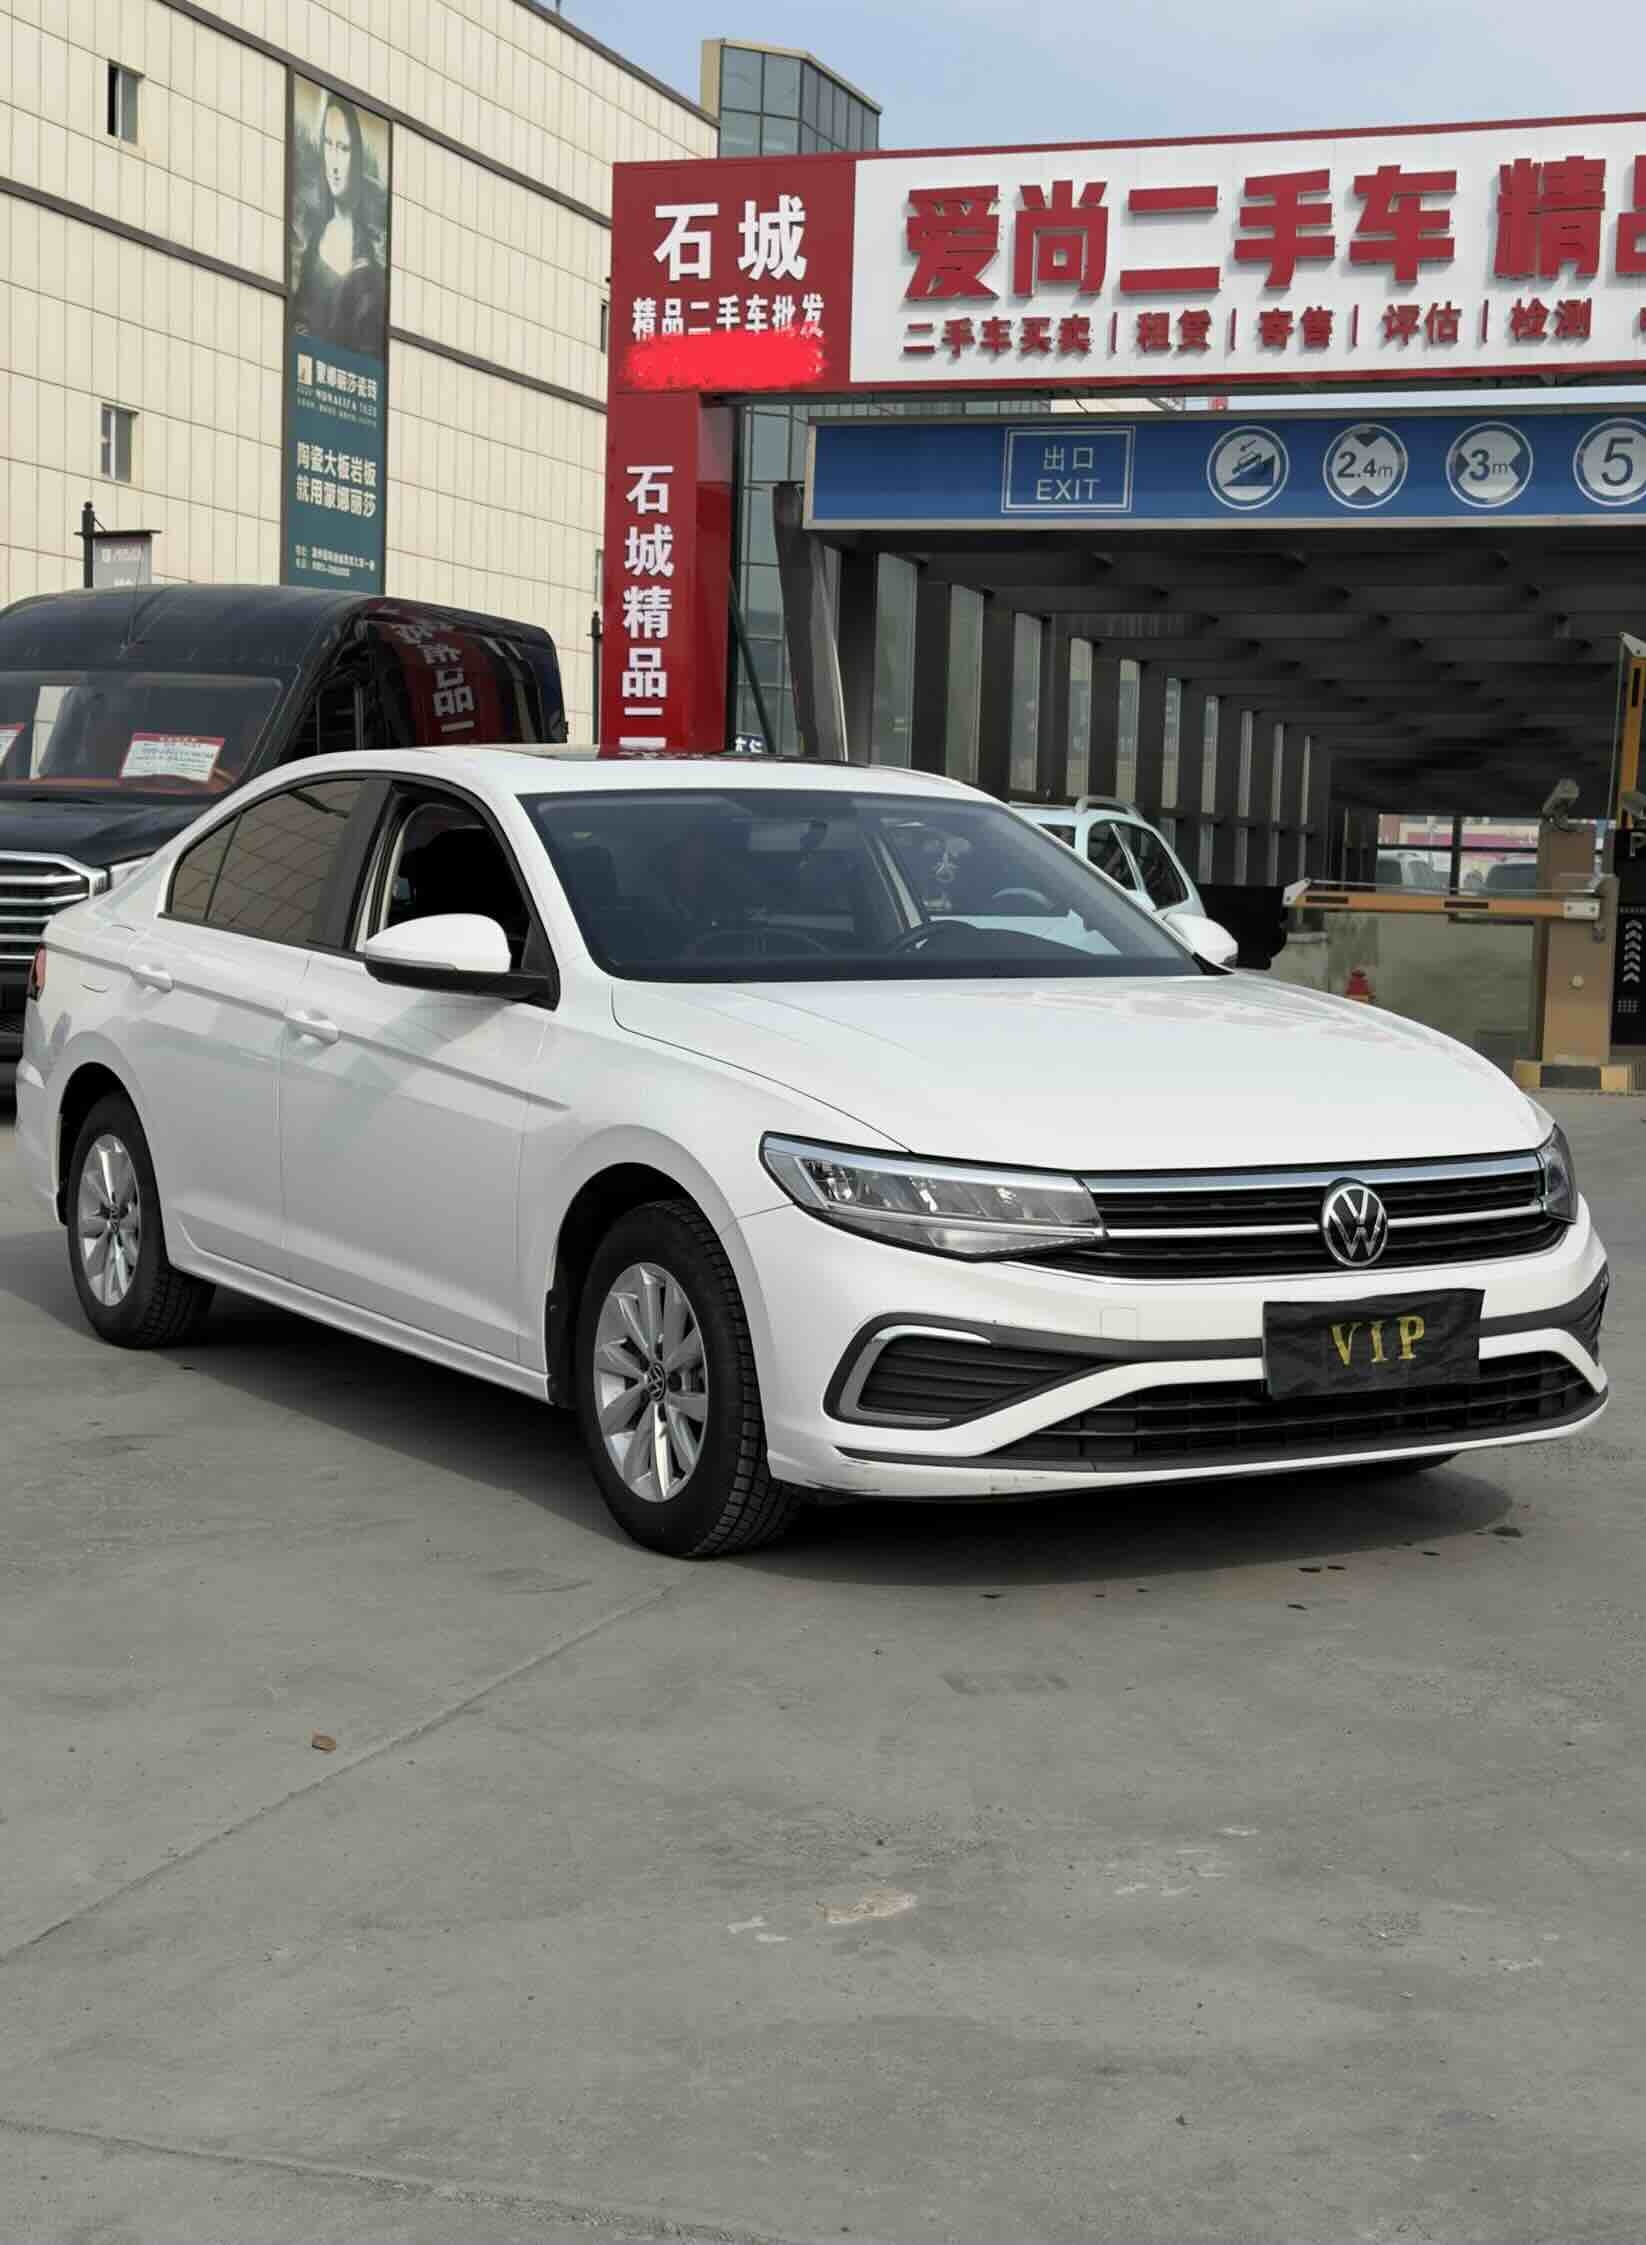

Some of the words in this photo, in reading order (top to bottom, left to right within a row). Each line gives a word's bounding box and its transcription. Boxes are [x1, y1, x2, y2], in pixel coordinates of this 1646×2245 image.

[654, 194, 807, 281] 石城
[903, 165, 1457, 300] 爱尚二手车
[632, 293, 824, 342] 精品二手车批发
[903, 314, 1092, 357] 二手车买卖
[1136, 309, 1212, 351] 租赁
[1258, 307, 1334, 349] 寄售
[1383, 301, 1462, 344] 评估
[1510, 298, 1592, 343] 检测
[1043, 445, 1094, 471] 出口
[1337, 451, 1393, 479] 2.4m
[1469, 449, 1508, 481] 3m
[1601, 437, 1633, 486] 5
[1036, 478, 1100, 500] EXIT
[1328, 1314, 1425, 1366] VIP
